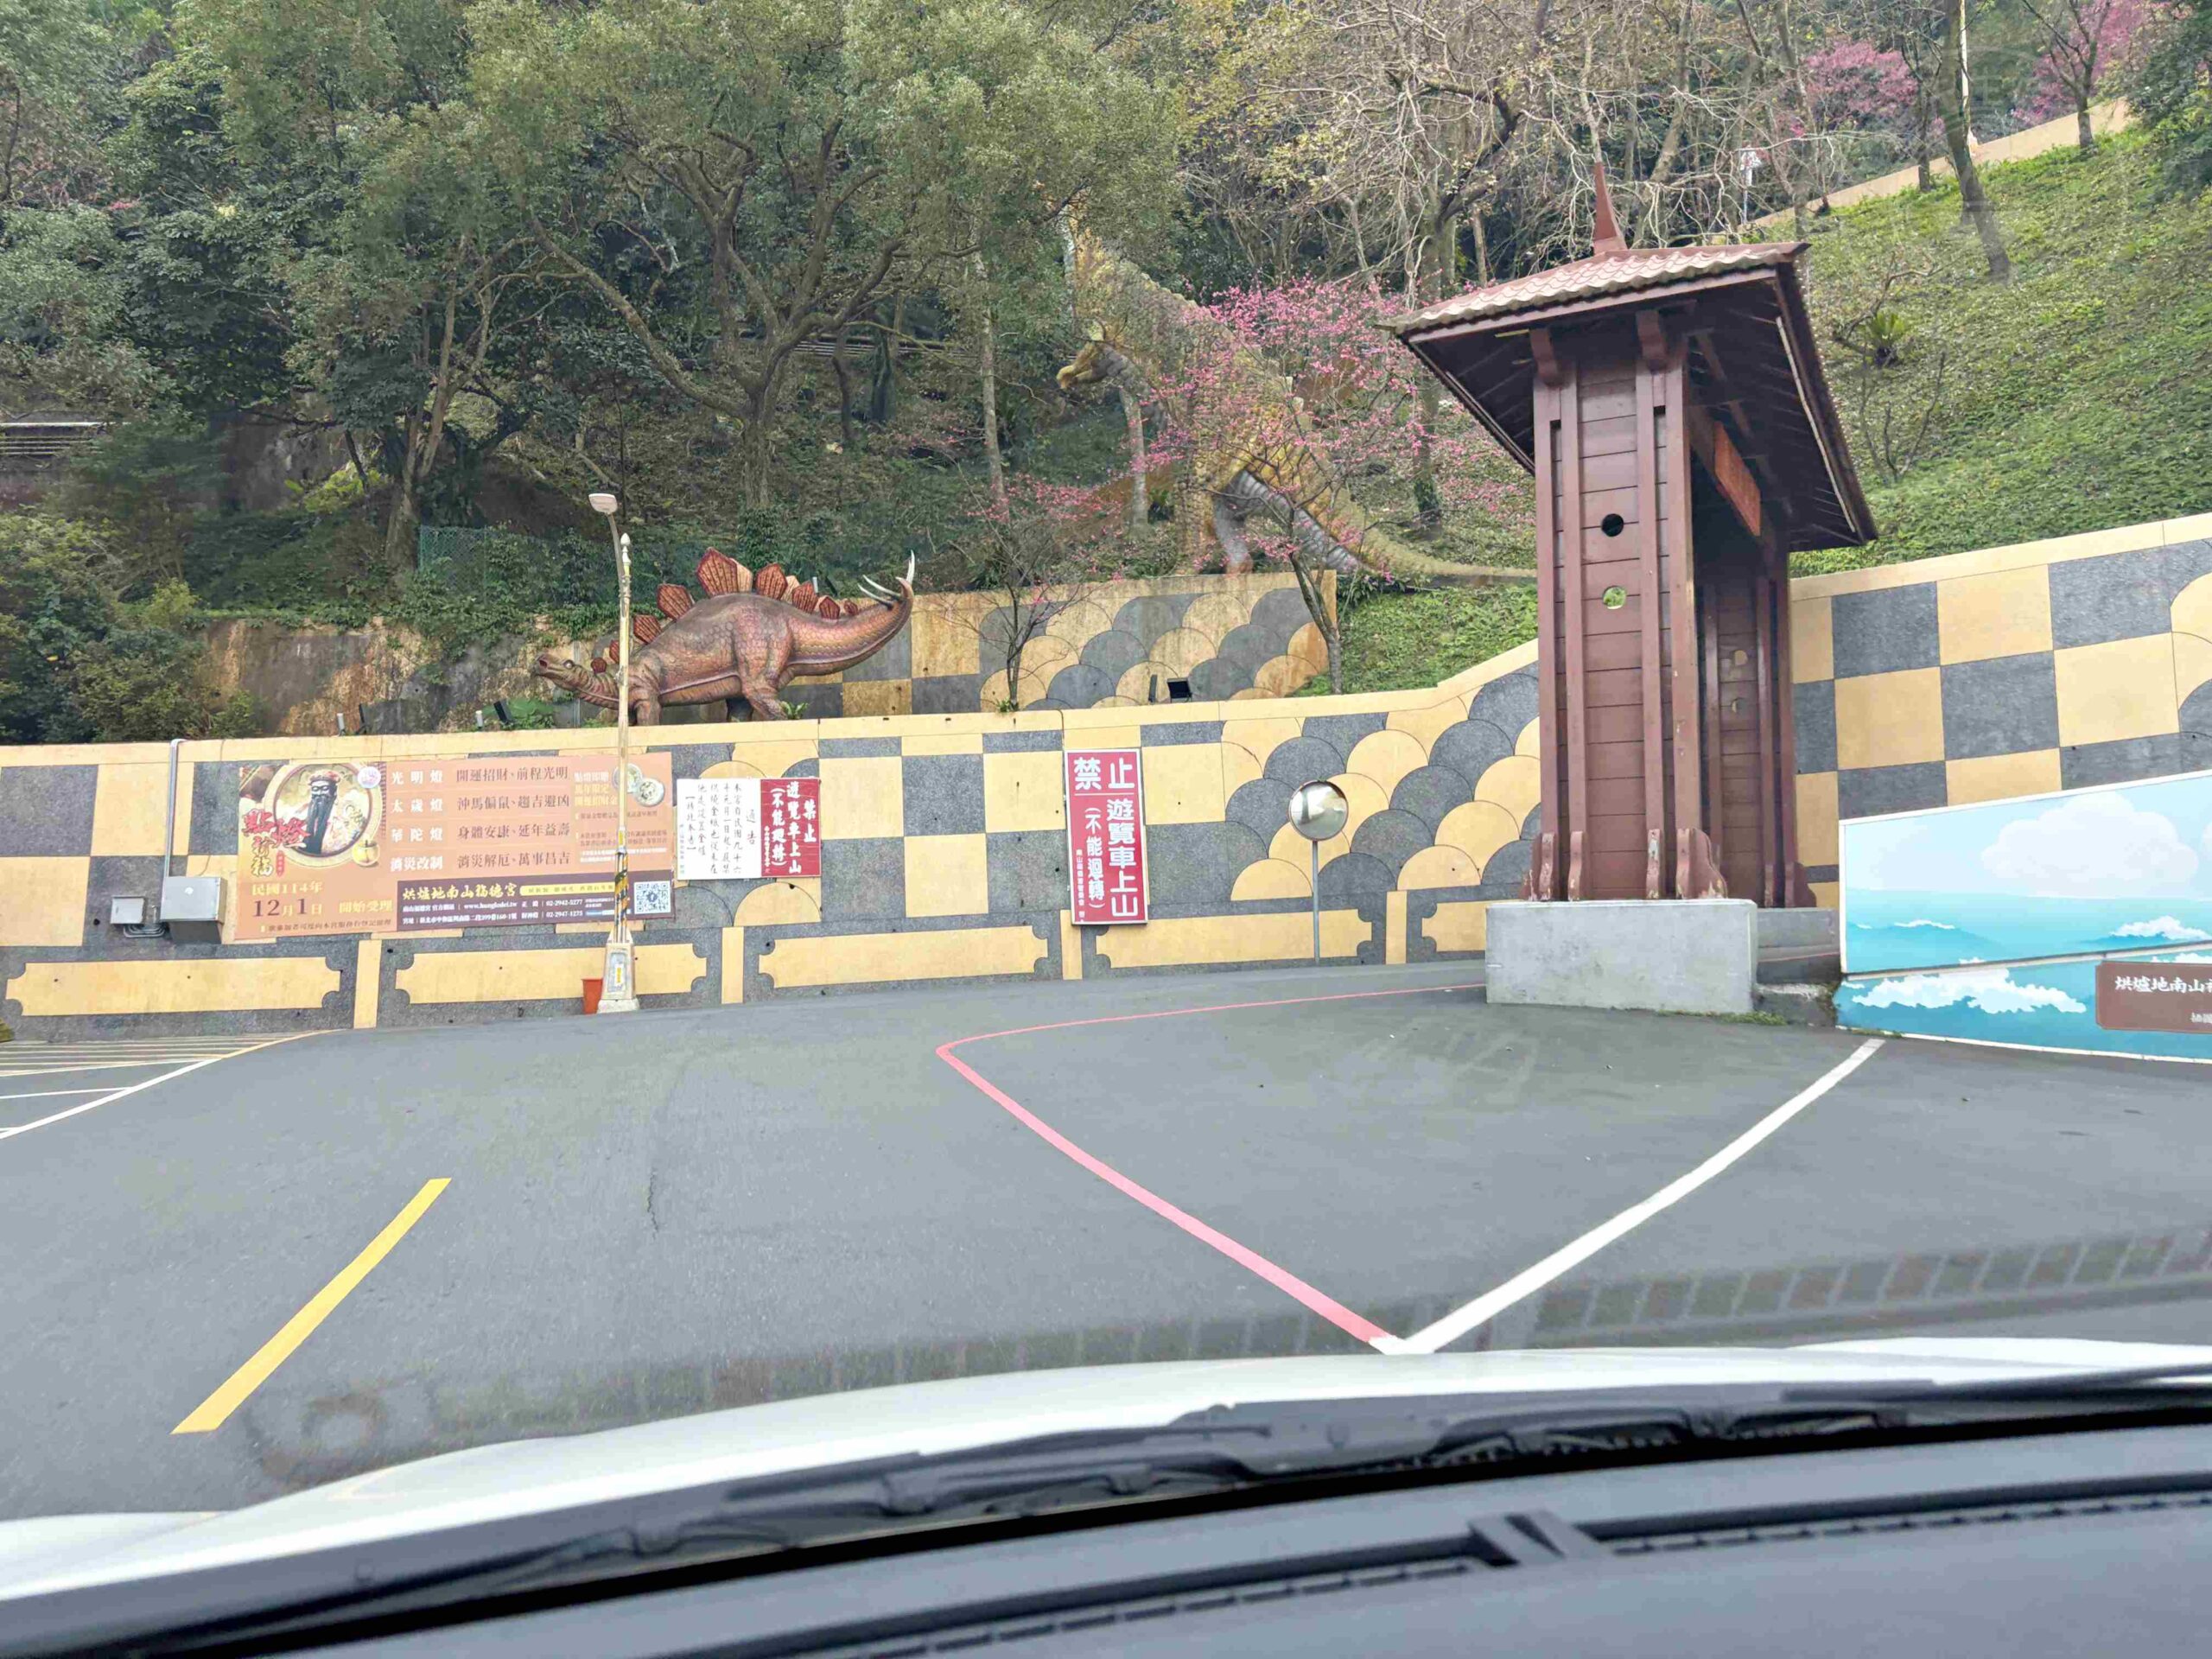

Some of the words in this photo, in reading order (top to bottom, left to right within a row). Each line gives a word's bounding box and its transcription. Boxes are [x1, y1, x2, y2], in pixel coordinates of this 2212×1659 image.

[391, 770, 443, 785] 光明燈
[456, 766, 569, 782] 開運招財、前程光明
[1074, 757, 1135, 791] 禁止
[391, 798, 443, 813] 太歲燈
[747, 809, 756, 845] 通告
[786, 781, 802, 874] 遊覽車上山
[803, 798, 817, 843] 禁止
[458, 823, 571, 839] 身體安康、延年益壽
[1106, 798, 1138, 917] 遊覽車上山
[252, 881, 323, 895] 民國114年
[403, 882, 518, 900] 烘爐地南山福德宮
[253, 898, 322, 917] 12月1日
[339, 899, 393, 913] 開始受理
